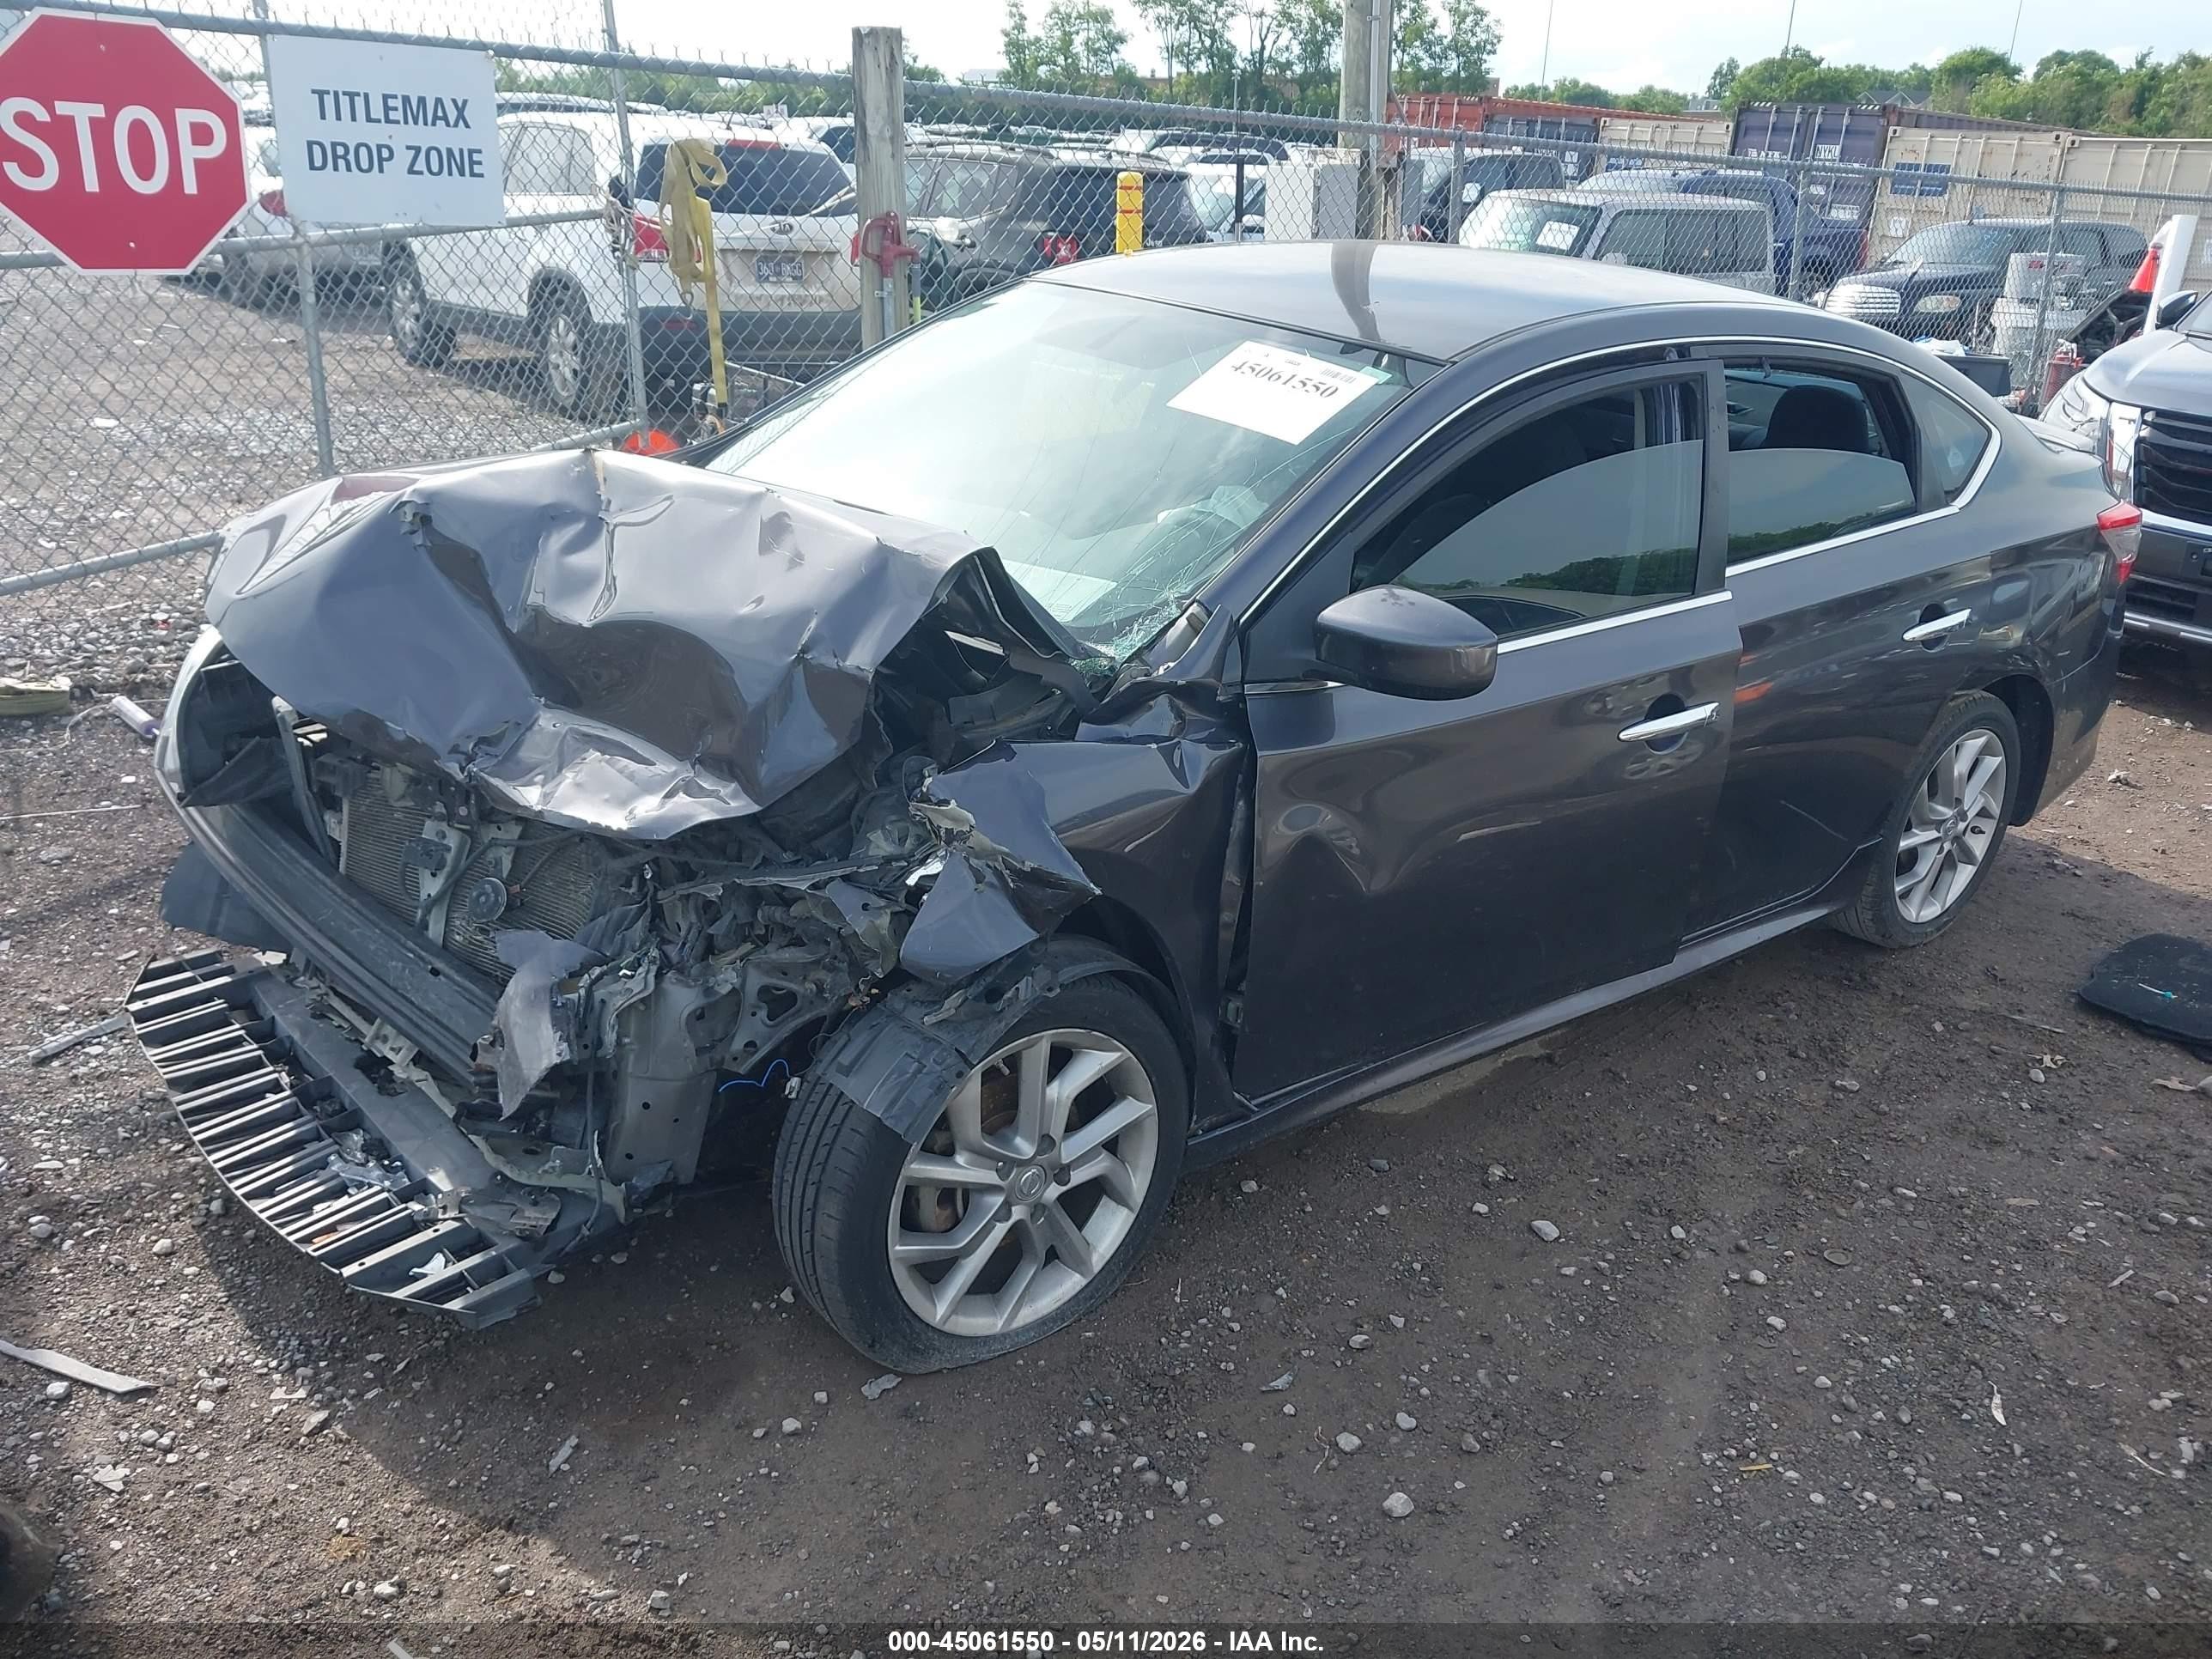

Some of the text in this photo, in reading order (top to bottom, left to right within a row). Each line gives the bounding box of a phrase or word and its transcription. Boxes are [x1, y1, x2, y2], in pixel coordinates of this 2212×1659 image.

[312, 88, 471, 129] TITLEMAX
[0, 96, 227, 195] STOP
[306, 140, 484, 179] DROP ZONE
[1231, 361, 1339, 398] 45061550
